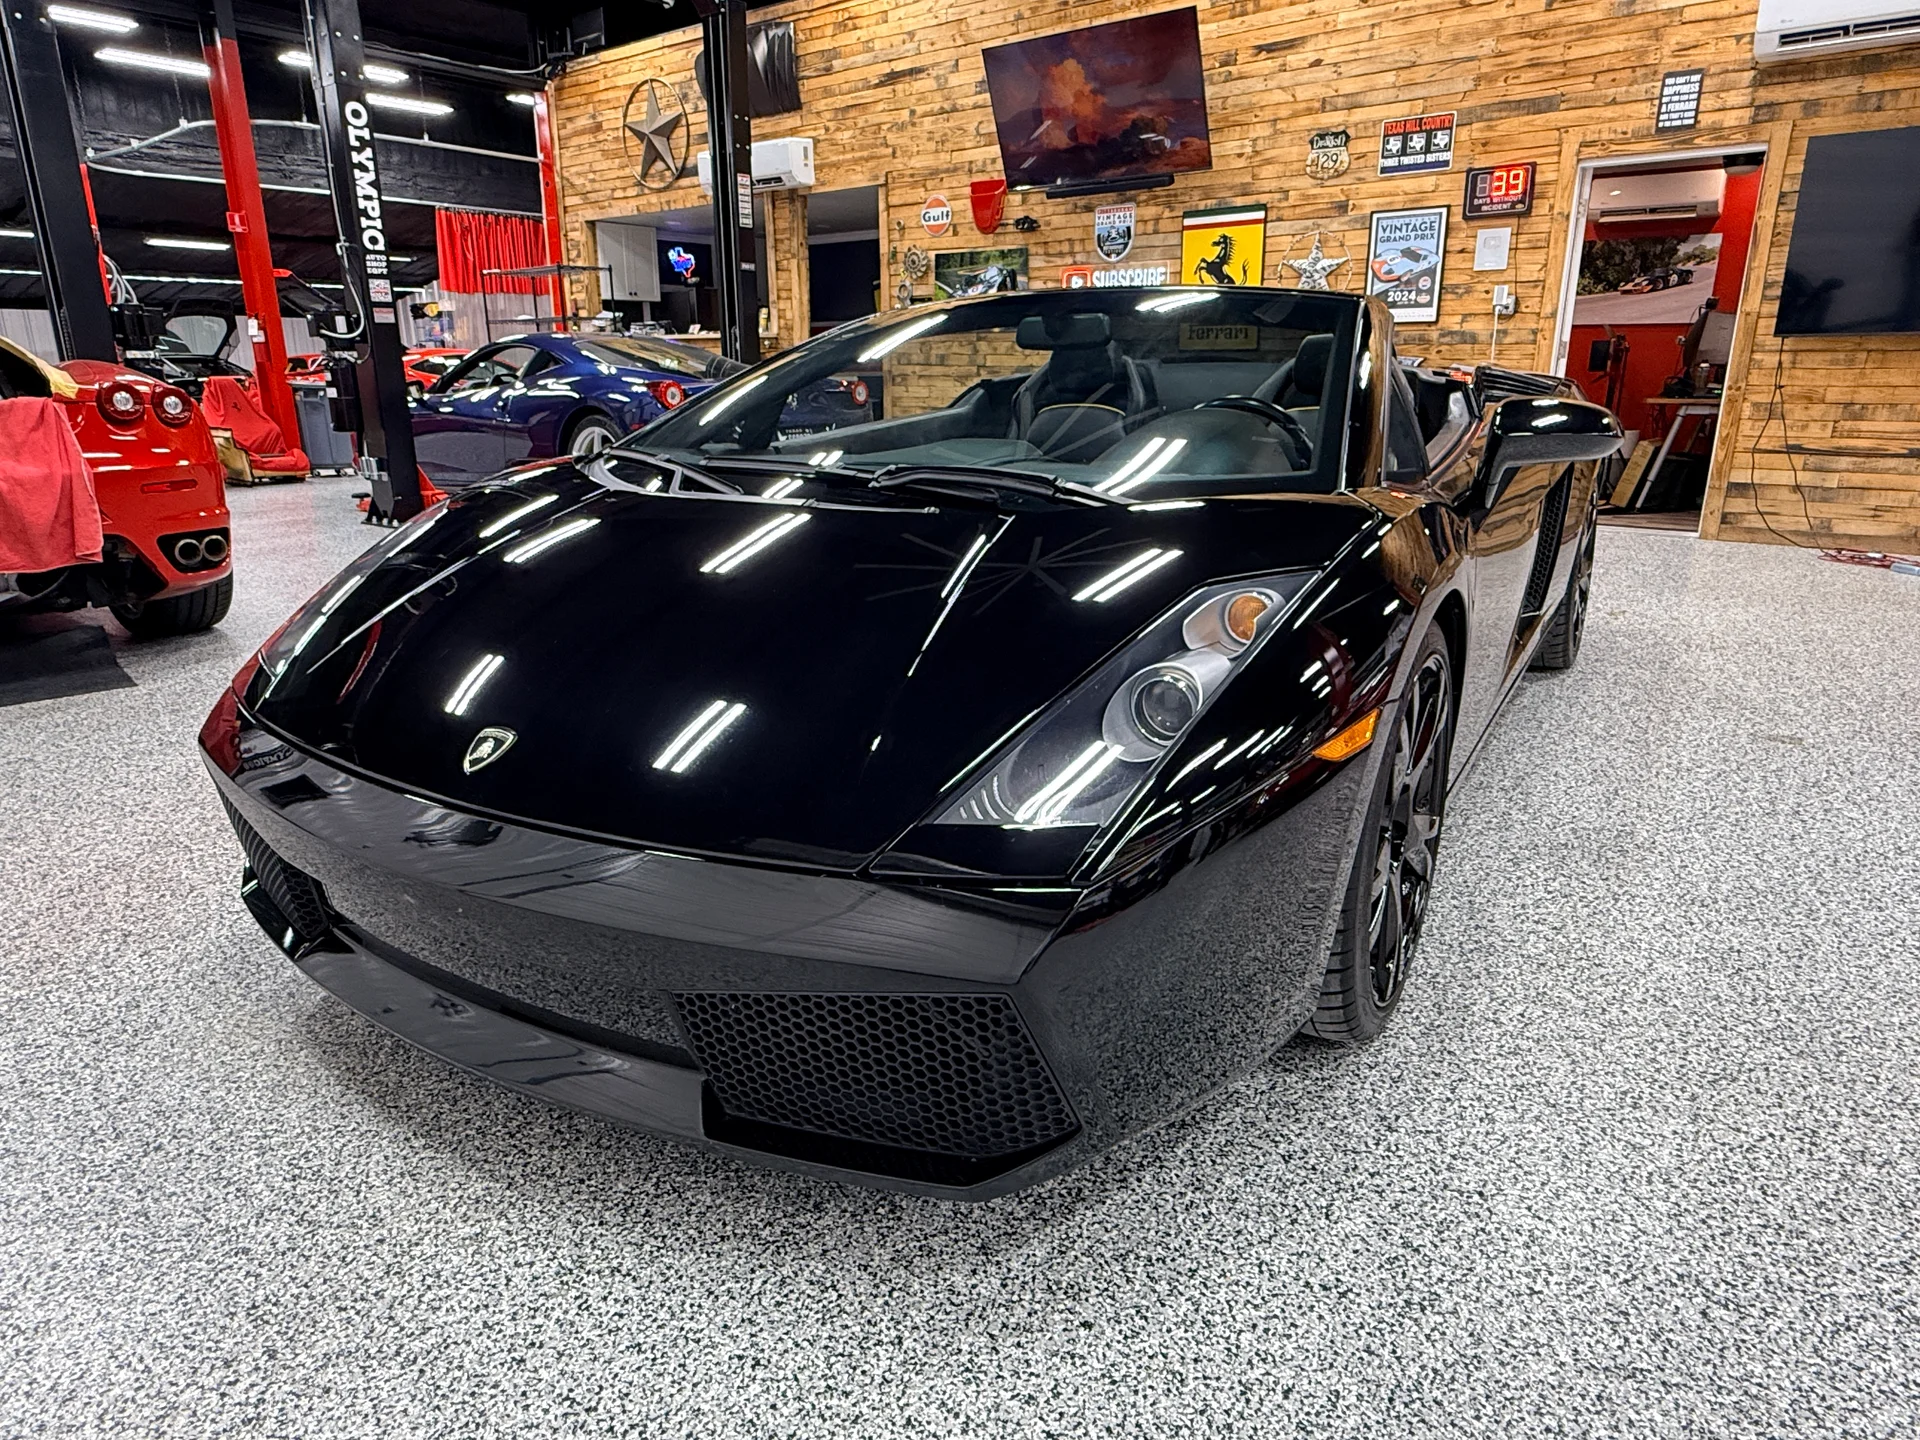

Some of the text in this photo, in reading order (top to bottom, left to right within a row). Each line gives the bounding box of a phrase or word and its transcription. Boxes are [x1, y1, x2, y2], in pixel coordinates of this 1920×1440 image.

[1663, 83, 1700, 95] HAPPINESS
[1667, 100, 1697, 112] FERRARI
[1385, 115, 1453, 135] TEXAS HILL COUNTRY
[1312, 152, 1339, 169] 129
[1380, 157, 1400, 167] THREE
[1400, 154, 1425, 165] TWISTED
[1425, 151, 1451, 162] SISTERS
[345, 101, 386, 251] OLYMPIC
[1492, 170, 1523, 196] 39
[1492, 195, 1522, 204] WITHOUT
[1481, 203, 1512, 211] INCIDENT
[922, 210, 950, 222] Gulf
[1097, 213, 1132, 221] VINTAGE
[1381, 221, 1436, 235] VINTAGE
[1380, 232, 1435, 244] GRAND PRIX
[1092, 267, 1166, 287] SUBSCRIBE
[1388, 290, 1416, 302] 2024
[1187, 325, 1249, 340] Ferrari
